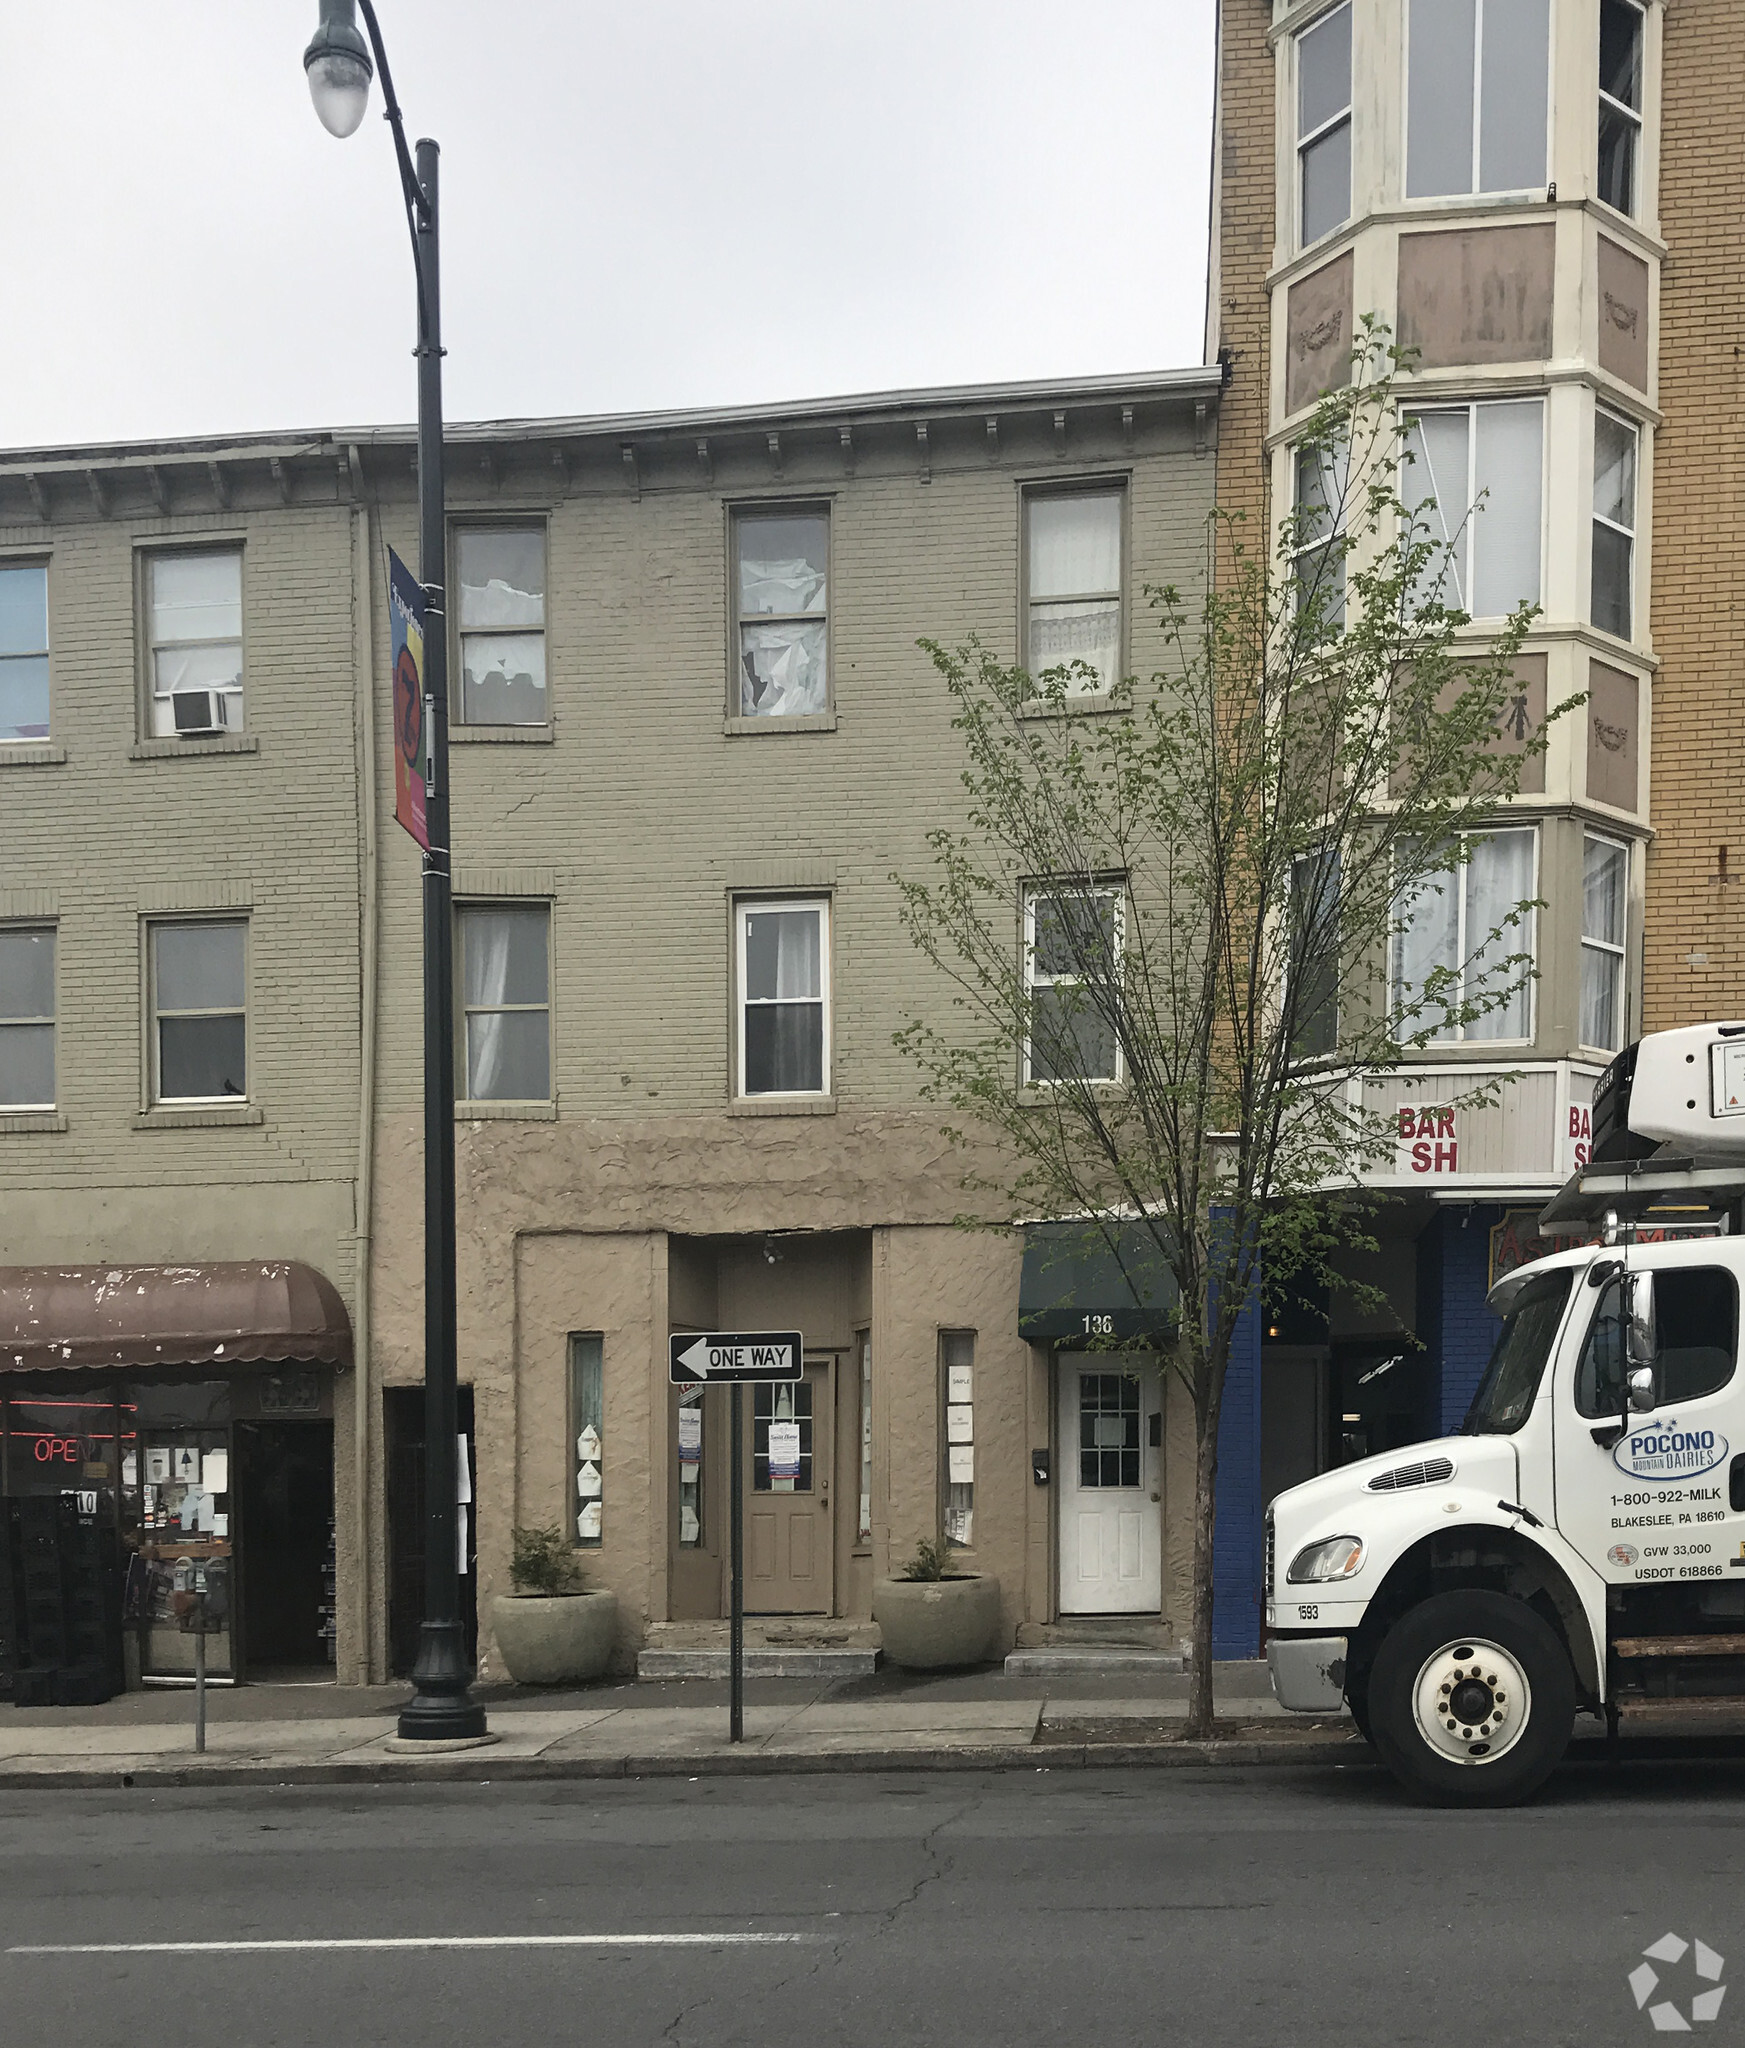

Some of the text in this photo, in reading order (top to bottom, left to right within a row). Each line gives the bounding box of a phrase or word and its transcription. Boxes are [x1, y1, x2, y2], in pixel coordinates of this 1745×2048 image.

[1398, 1107, 1456, 1140] BAR
[1569, 1106, 1591, 1139] BA
[1411, 1142, 1458, 1173] SH
[1498, 1225, 1607, 1264] ASTR
[1082, 1314, 1113, 1334] 136
[709, 1345, 788, 1368] ONE WAY
[34, 1439, 92, 1462] OPEN
[1630, 1430, 1715, 1456] POCONO
[1632, 1450, 1714, 1472] MOUNTAIN DAIRIES
[1610, 1488, 1722, 1506] 1-800-922-MILK
[956, 1511, 965, 1541] RENT
[1611, 1511, 1725, 1528] BLAKESLEE, PA 18610
[1643, 1547, 1669, 1557] GVW
[1673, 1544, 1712, 1556] 33,000
[1635, 1565, 1723, 1579] USDOT 618866
[1297, 1604, 1319, 1620] 1593
